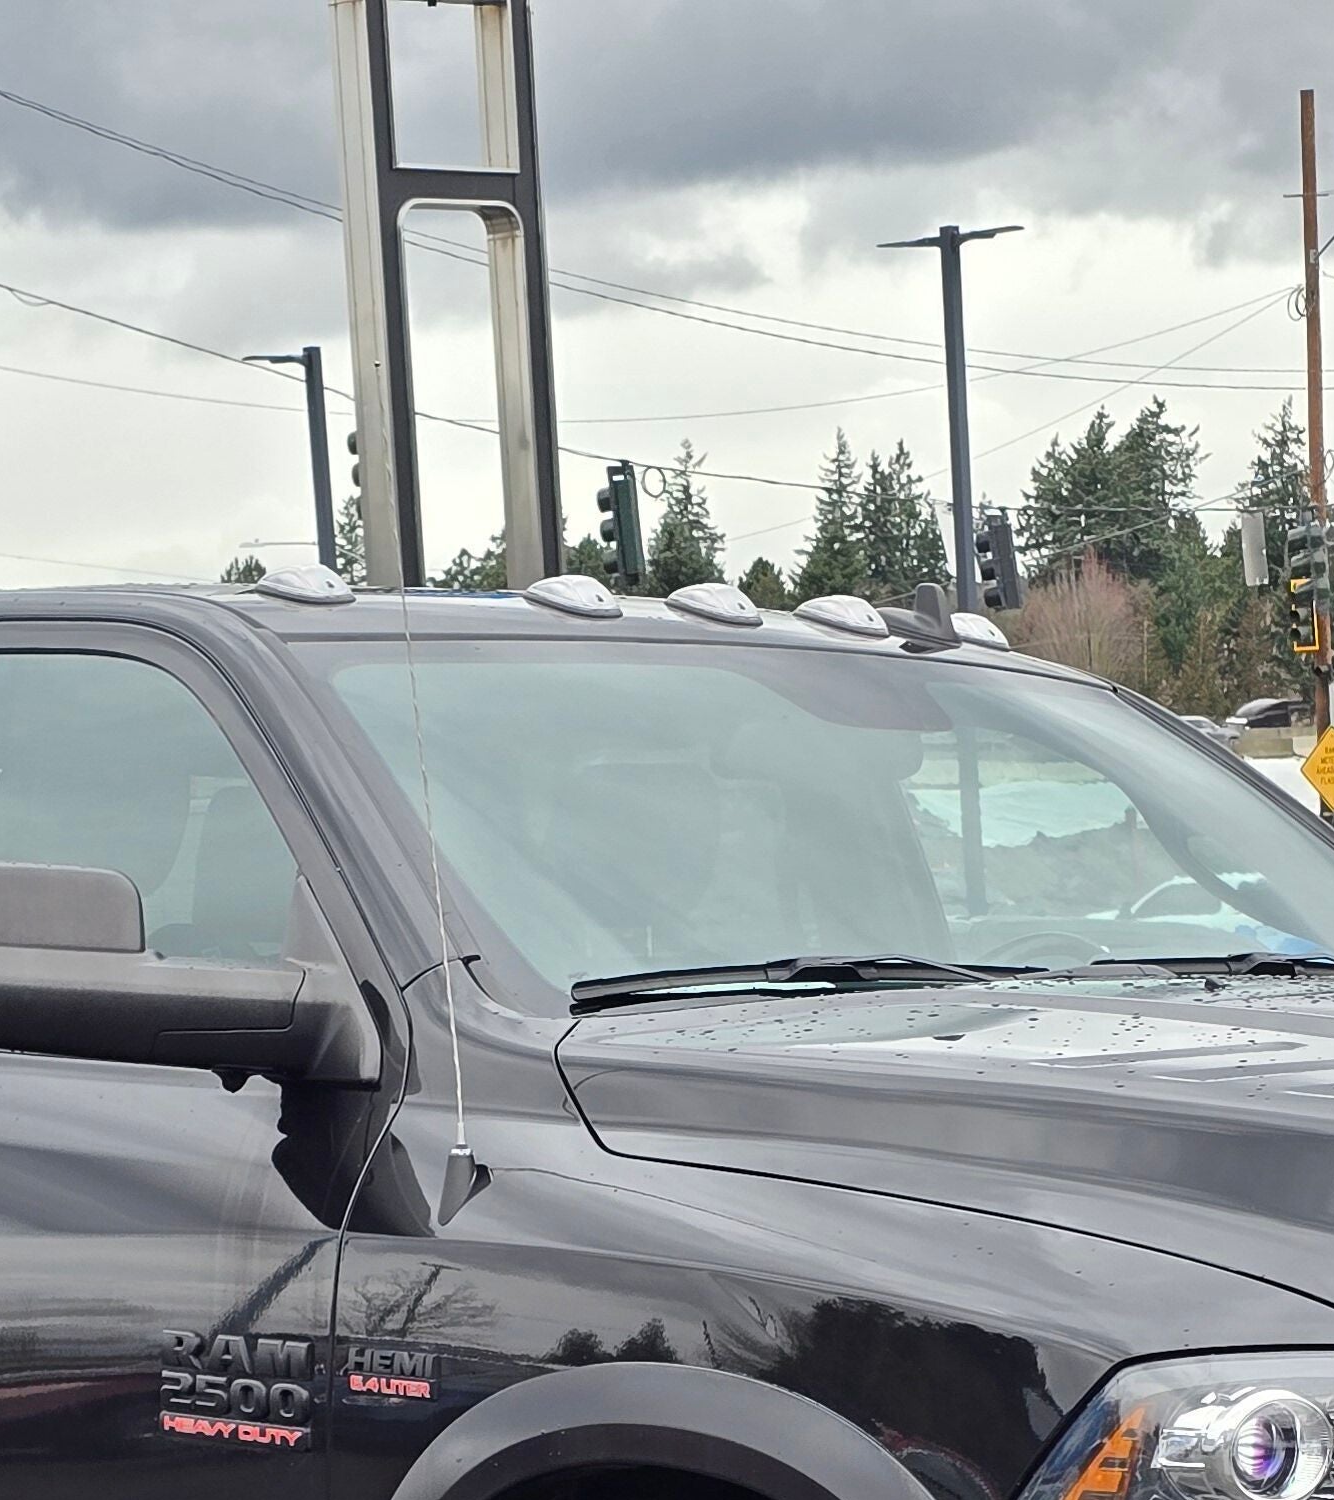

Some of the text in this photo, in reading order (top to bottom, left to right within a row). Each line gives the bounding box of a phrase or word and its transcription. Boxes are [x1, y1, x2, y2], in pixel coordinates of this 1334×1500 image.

[1316, 765, 1334, 775] AHEAD
[163, 1329, 315, 1379] RAM
[347, 1347, 436, 1378] HEMI
[160, 1370, 312, 1422] 2500
[380, 1377, 431, 1398] LITER
[163, 1414, 303, 1447] HEAVY DUTY
